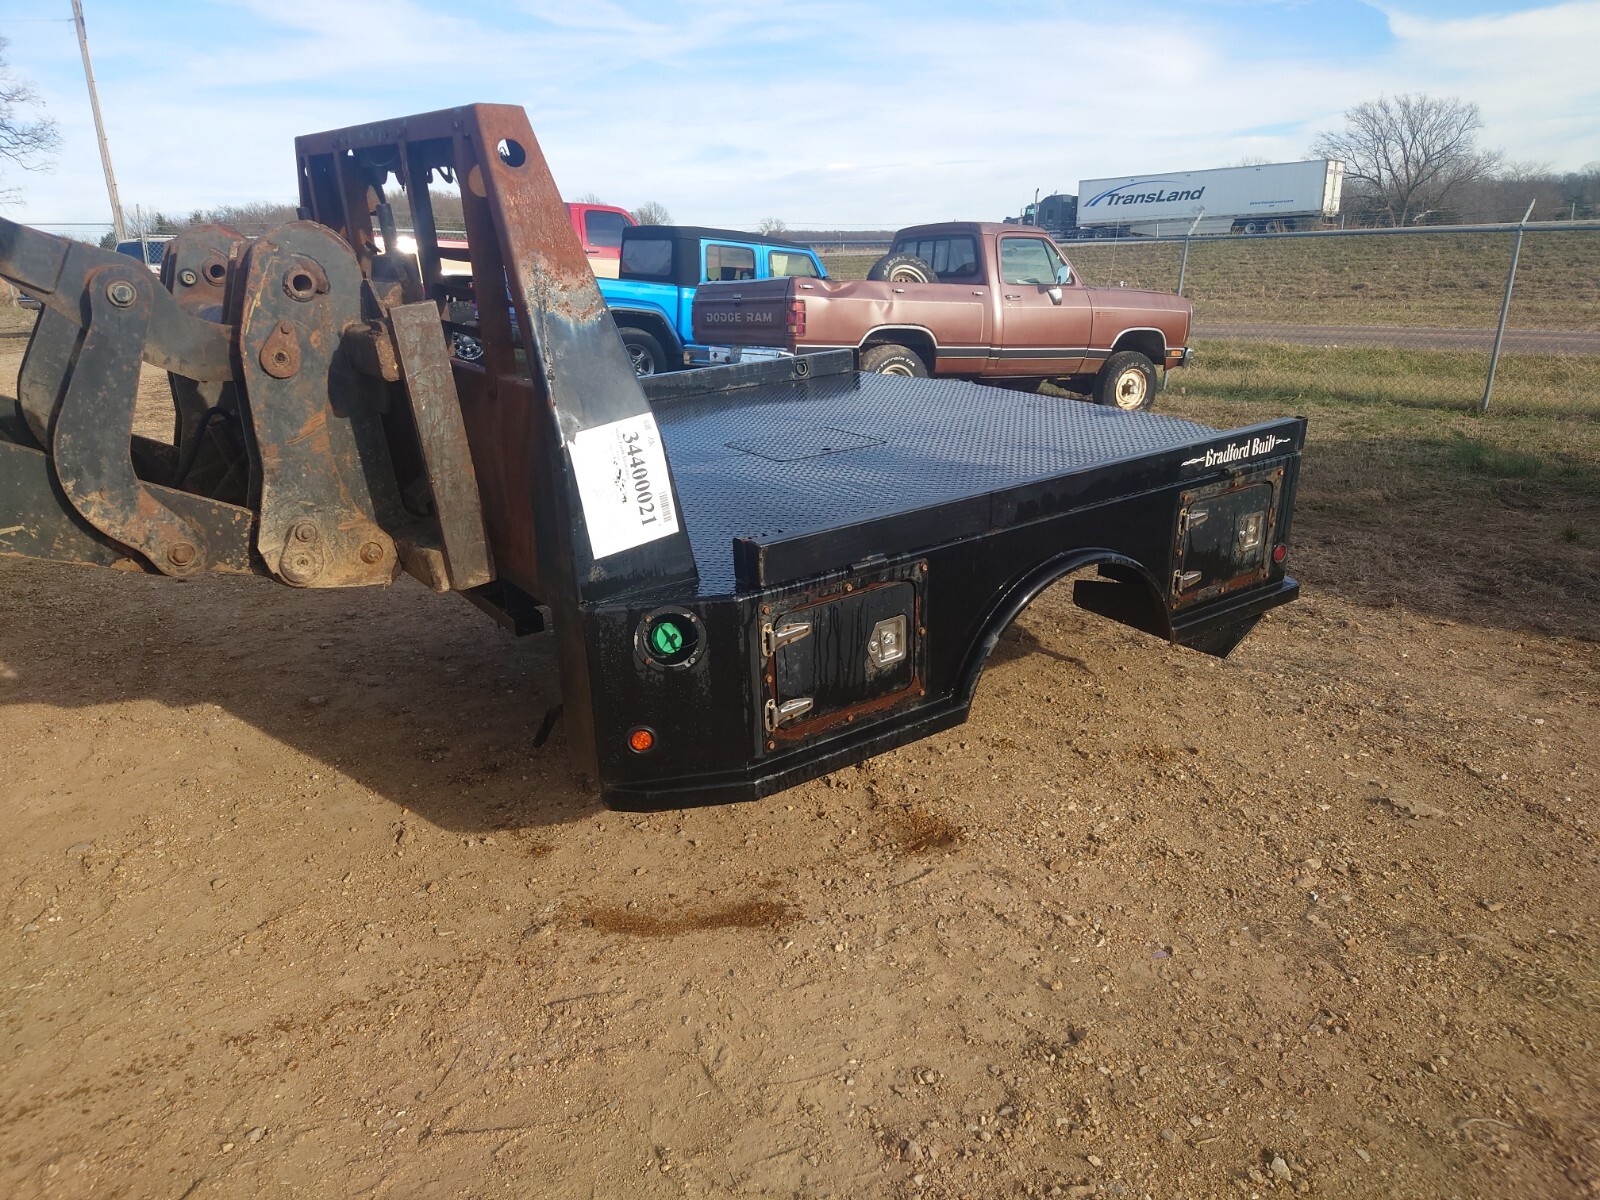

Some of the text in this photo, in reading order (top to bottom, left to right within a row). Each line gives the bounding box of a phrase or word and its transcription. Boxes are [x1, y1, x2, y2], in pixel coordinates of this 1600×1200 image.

[1107, 186, 1206, 206] TransLand
[706, 312, 772, 322] DODGE RAM
[1204, 434, 1277, 467] Bradford Built
[622, 431, 658, 526] 34400021
